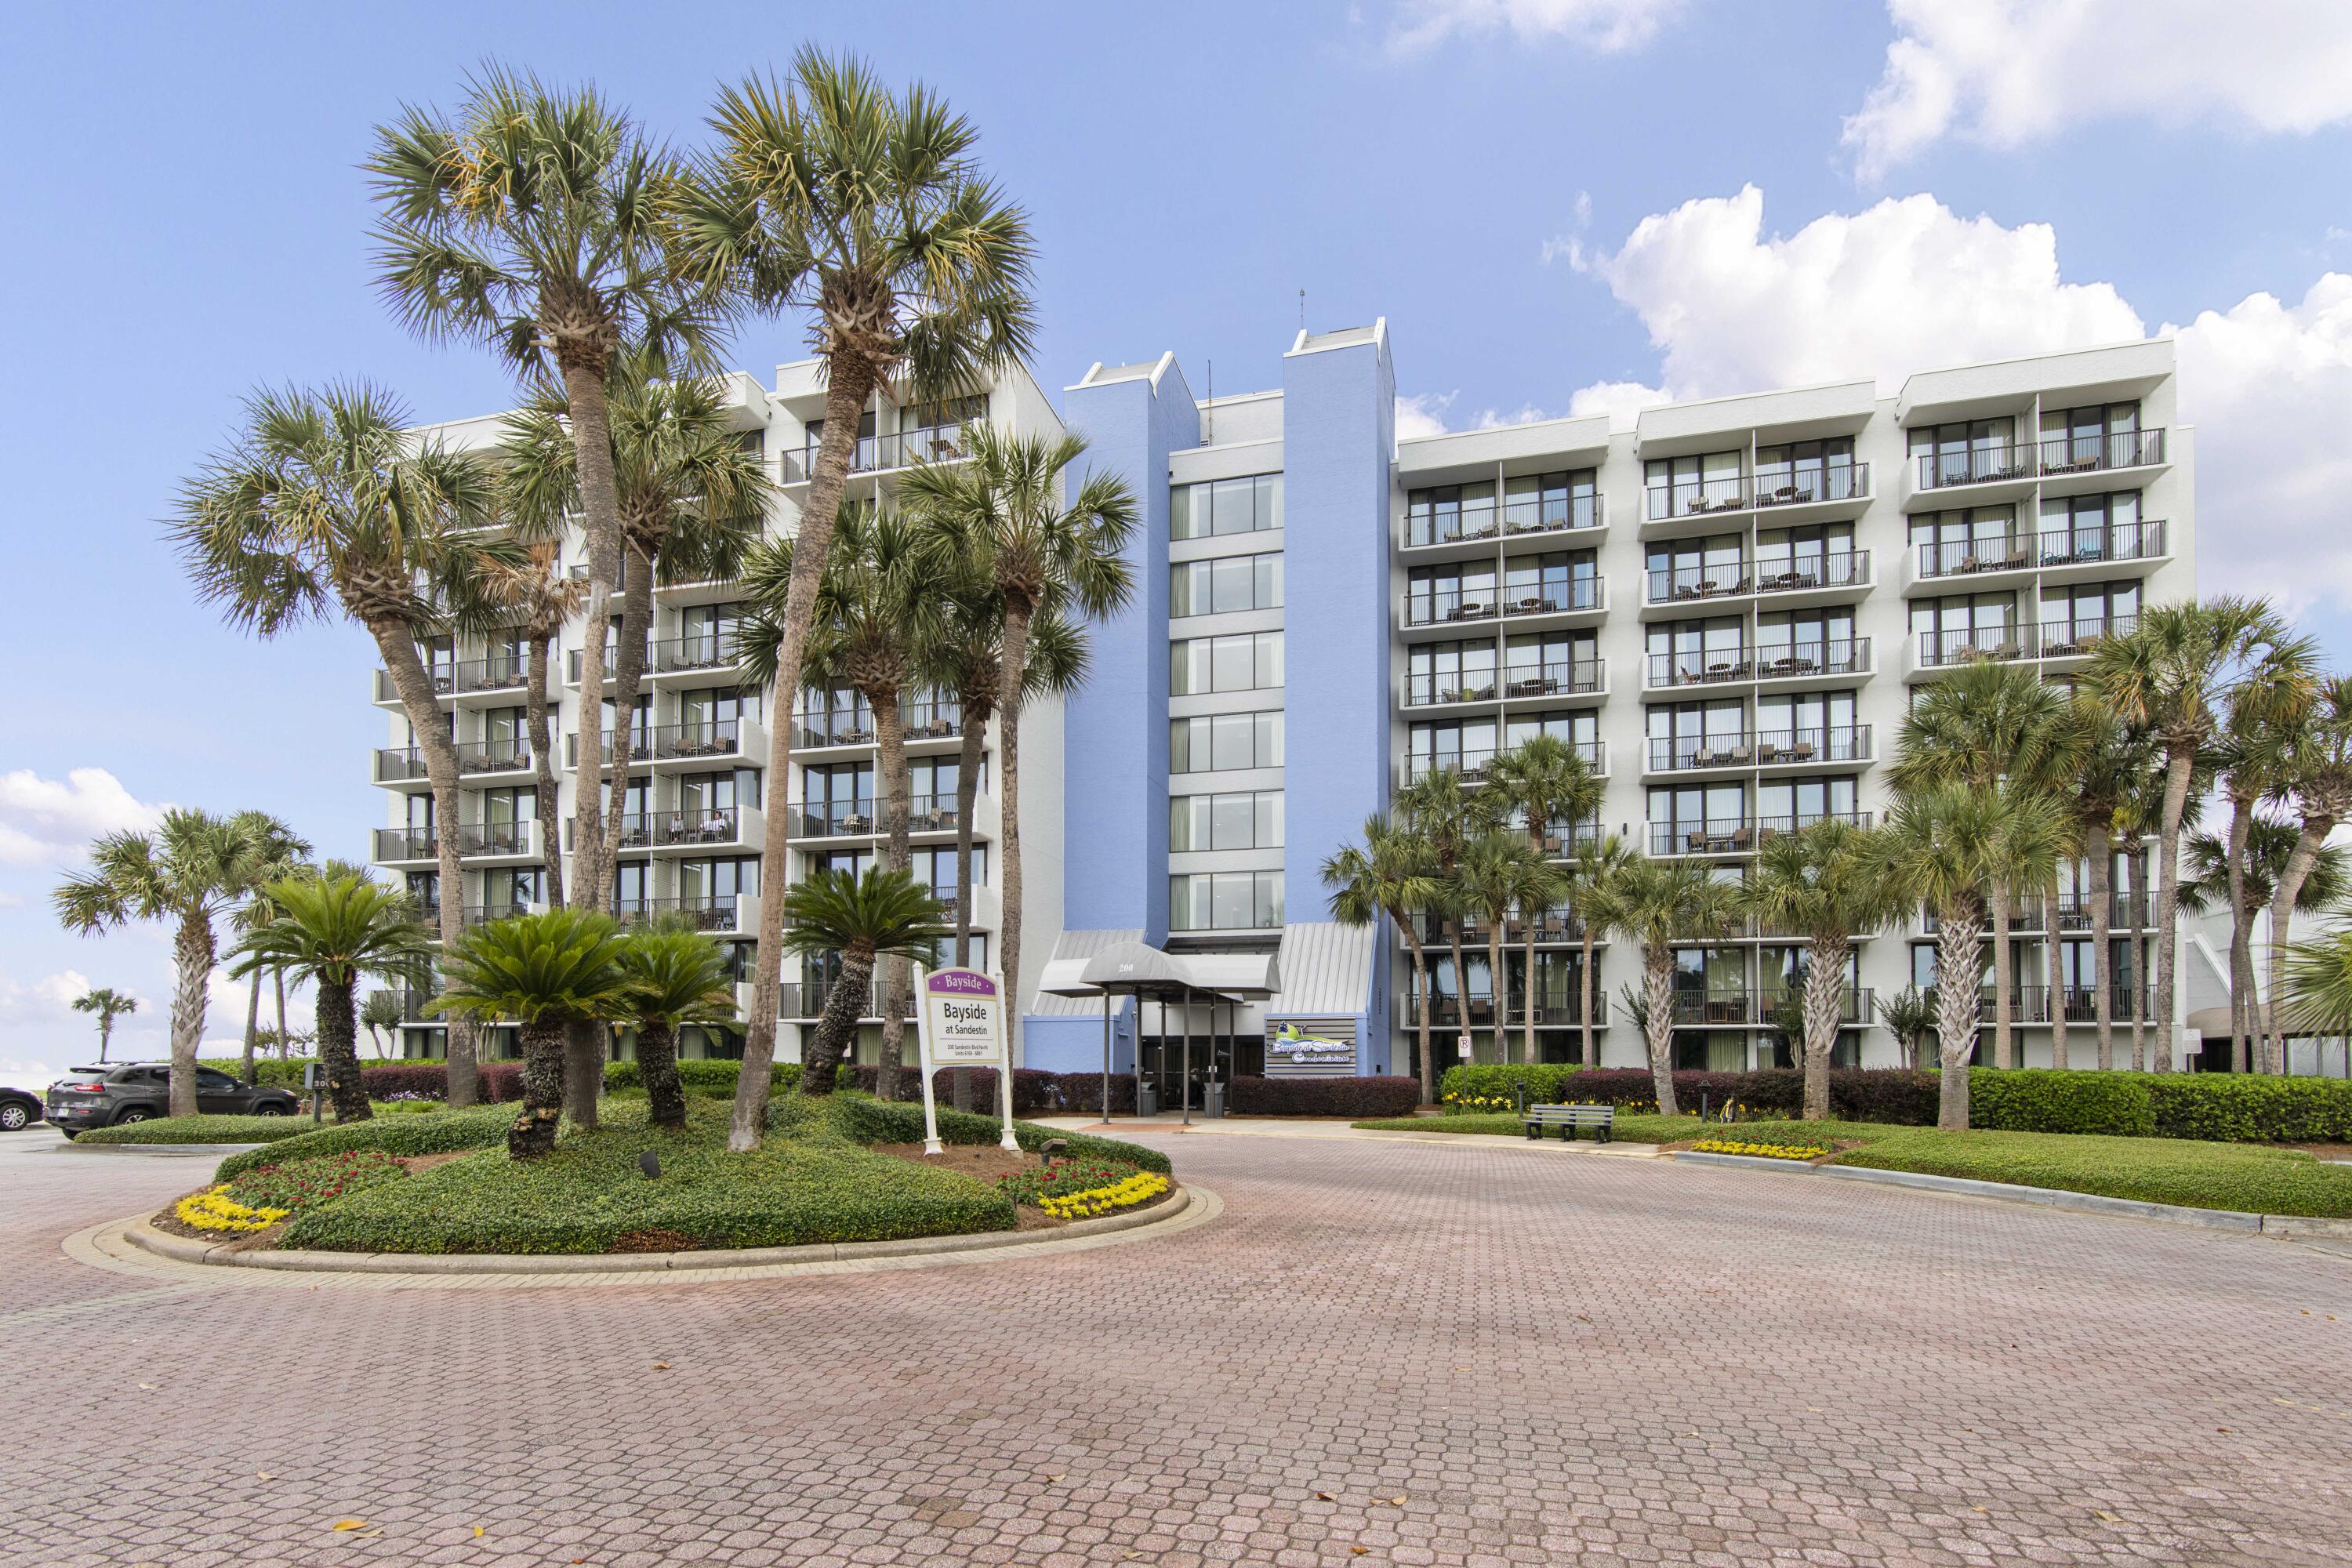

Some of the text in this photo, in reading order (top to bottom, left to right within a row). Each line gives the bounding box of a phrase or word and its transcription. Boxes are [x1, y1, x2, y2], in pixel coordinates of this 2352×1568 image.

[1119, 964, 1134, 973] 200
[945, 975, 982, 990] Bayside
[944, 1003, 987, 1023] Bayside
[946, 1025, 988, 1035] at Sandestin
[1270, 1041, 1301, 1054] Bayside
[1311, 1040, 1349, 1052] Sandestin
[1292, 1052, 1350, 1064] Condominium
